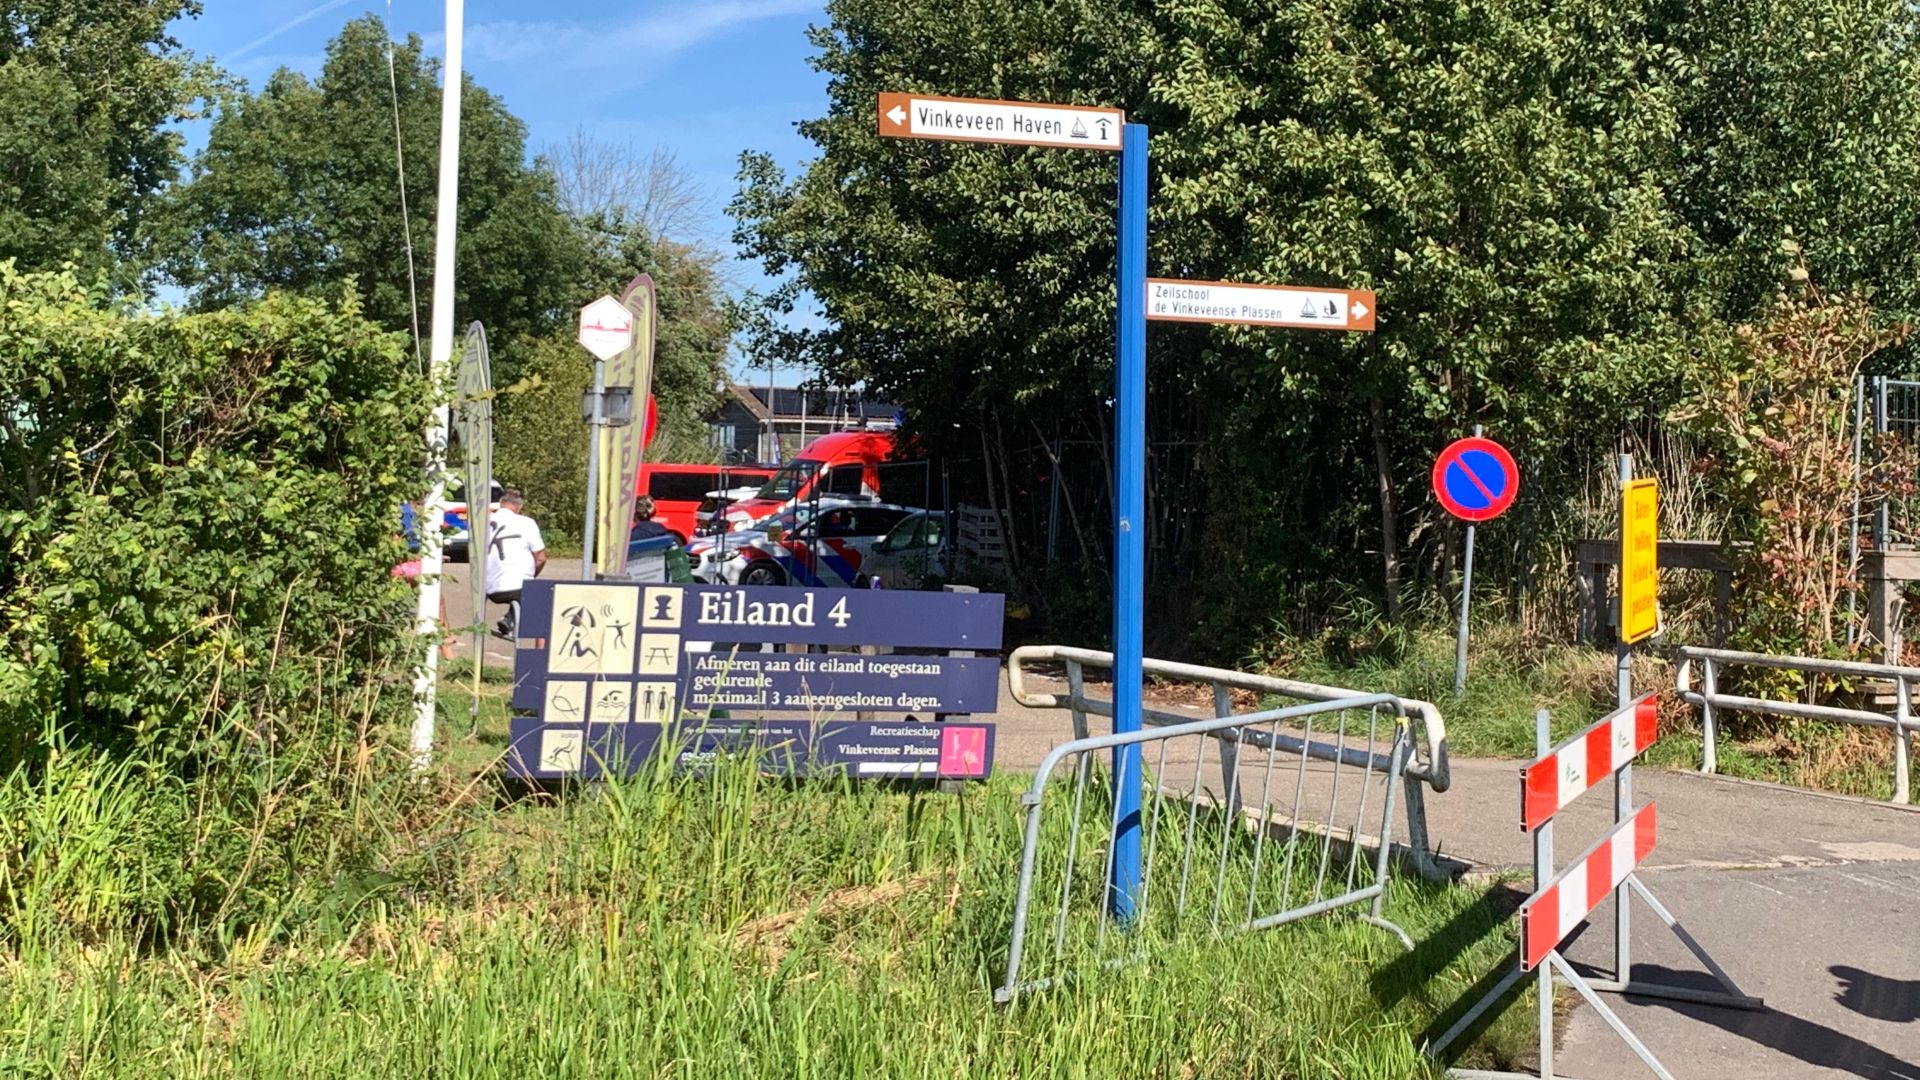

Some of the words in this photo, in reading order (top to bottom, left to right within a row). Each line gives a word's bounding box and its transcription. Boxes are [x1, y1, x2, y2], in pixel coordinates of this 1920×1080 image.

[918, 107, 1004, 131] Vinkeveen
[1013, 113, 1062, 135] Haven
[1155, 285, 1210, 301] Zeilschool
[1154, 301, 1167, 313] de
[1172, 301, 1237, 317] Vinkeveense
[1242, 305, 1282, 319] Plassen
[698, 590, 815, 626] Eiland
[827, 596, 851, 628] 4
[696, 656, 760, 672] Afmeren
[765, 659, 790, 672] aan
[795, 657, 815, 673] dit
[820, 658, 864, 674] eiland
[869, 661, 941, 678] toegestaan
[693, 672, 773, 690] gedurende
[693, 690, 766, 705] maximaal
[771, 692, 780, 705] 3
[784, 692, 893, 711] aaneengesloten
[897, 693, 942, 711] dagen.
[870, 725, 941, 739] Recreatieschap
[839, 744, 901, 755] Vinkeveense
[903, 744, 939, 755] Plassen
